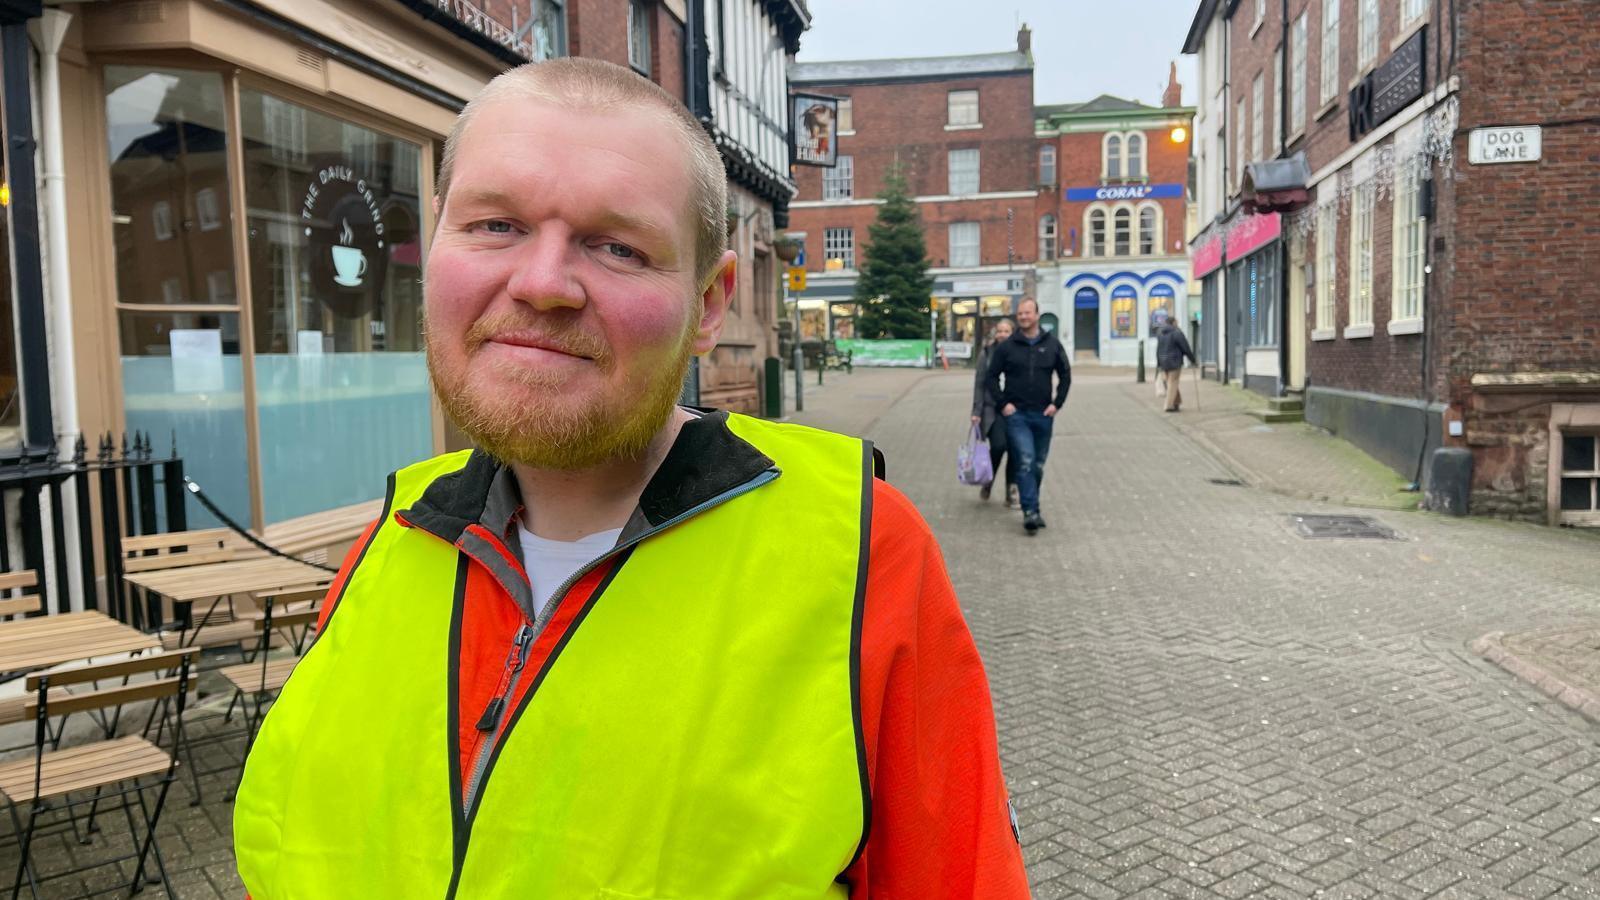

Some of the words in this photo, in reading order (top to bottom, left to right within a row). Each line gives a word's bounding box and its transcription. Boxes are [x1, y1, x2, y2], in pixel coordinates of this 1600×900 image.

[1487, 132, 1525, 145] DOG
[1483, 145, 1528, 160] LANE
[302, 182, 320, 219] THE
[319, 165, 352, 185] DAILY
[357, 179, 384, 235] GRIND
[1096, 186, 1145, 200] CORAL
